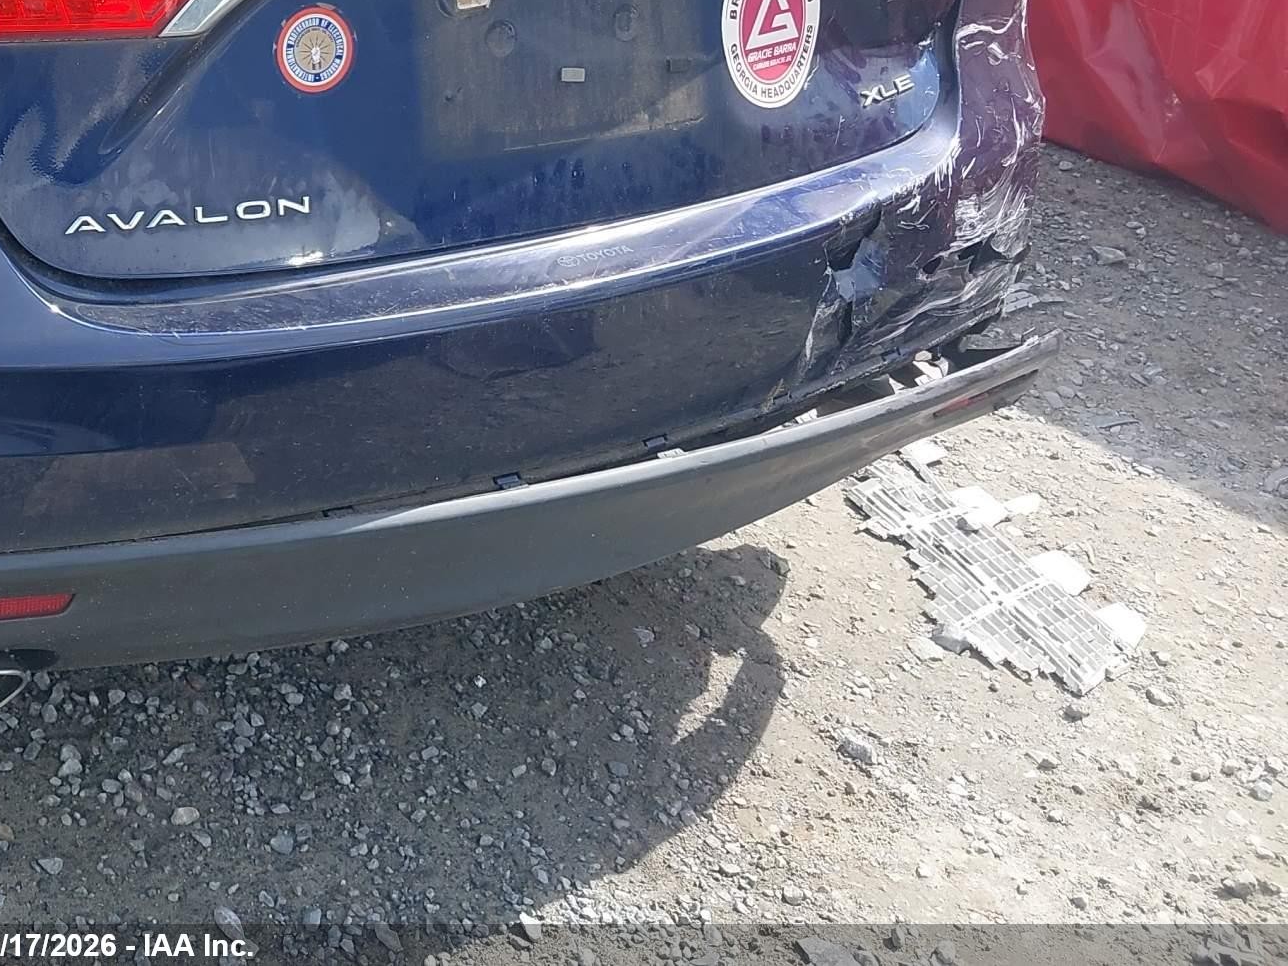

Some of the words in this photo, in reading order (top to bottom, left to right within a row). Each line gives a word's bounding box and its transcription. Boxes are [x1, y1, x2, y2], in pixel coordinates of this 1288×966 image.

[730, 43, 758, 95] GEORGIA
[761, 25, 813, 98] HEADQUARTERS
[747, 47, 773, 63] GRACIE
[773, 41, 797, 56] BARRA
[860, 74, 915, 108] XLE
[64, 196, 310, 235] AVALON
[575, 245, 634, 262] TOYOTA
